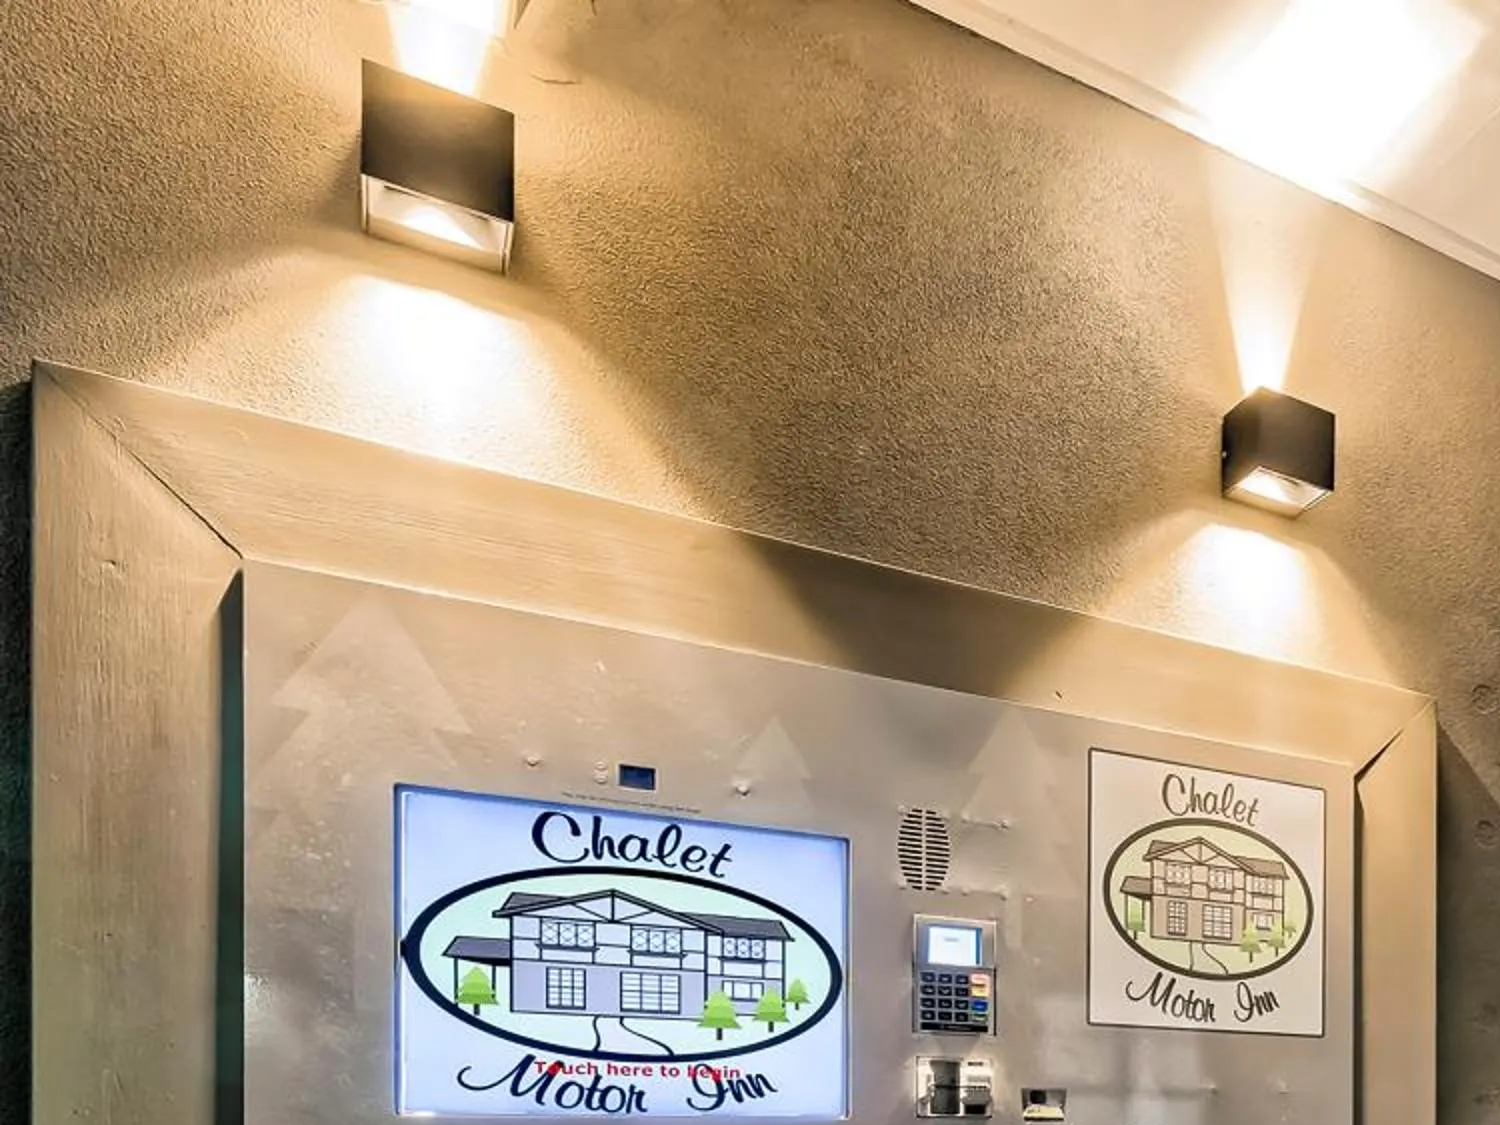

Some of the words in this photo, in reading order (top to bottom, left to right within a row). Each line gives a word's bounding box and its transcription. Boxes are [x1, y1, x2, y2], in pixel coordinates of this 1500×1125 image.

[1162, 773, 1262, 828] Chalet
[531, 811, 734, 878] Chalet
[1125, 971, 1218, 1024] Motor
[1232, 981, 1280, 1022] Inn
[457, 1053, 648, 1114] Motor
[687, 1063, 777, 1111] Inn
[606, 1061, 653, 1078] here
[660, 1063, 680, 1078] to
